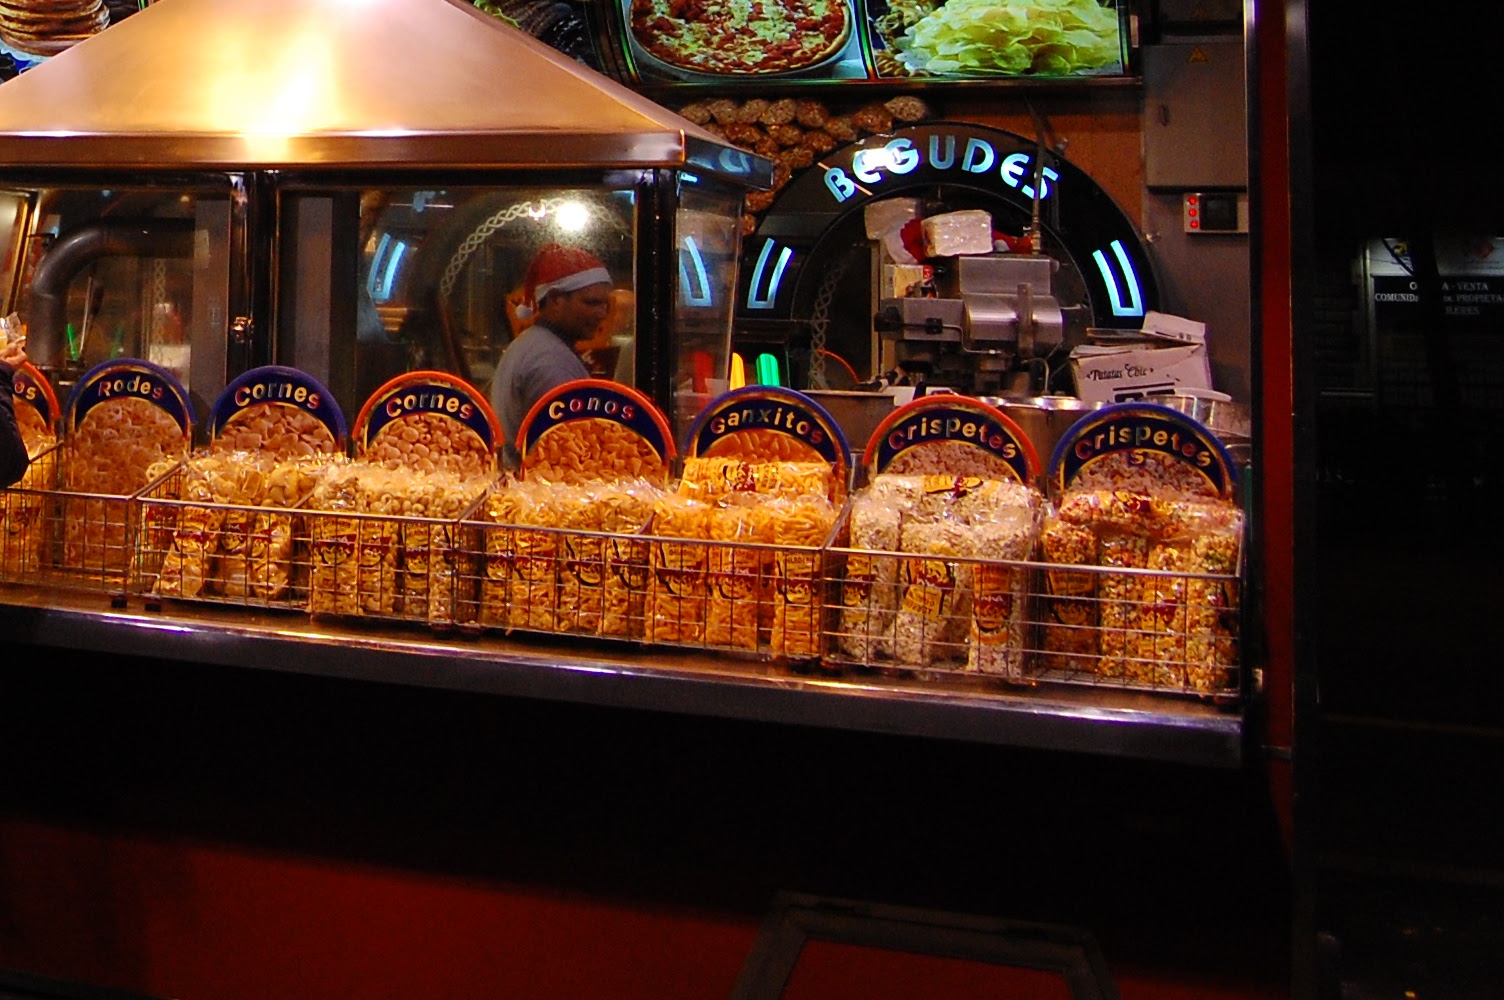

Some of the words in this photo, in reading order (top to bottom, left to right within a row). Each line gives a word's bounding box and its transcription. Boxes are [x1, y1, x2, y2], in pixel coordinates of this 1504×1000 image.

[824, 135, 1060, 203] BEGUDES
[97, 375, 164, 399] Rodes
[234, 382, 321, 410] Cornes
[385, 391, 474, 420] Cornes
[548, 391, 635, 421] Conos
[709, 406, 823, 445] Ganxitos
[887, 416, 1018, 460] Crispetes
[1074, 424, 1211, 467] Crispetes
